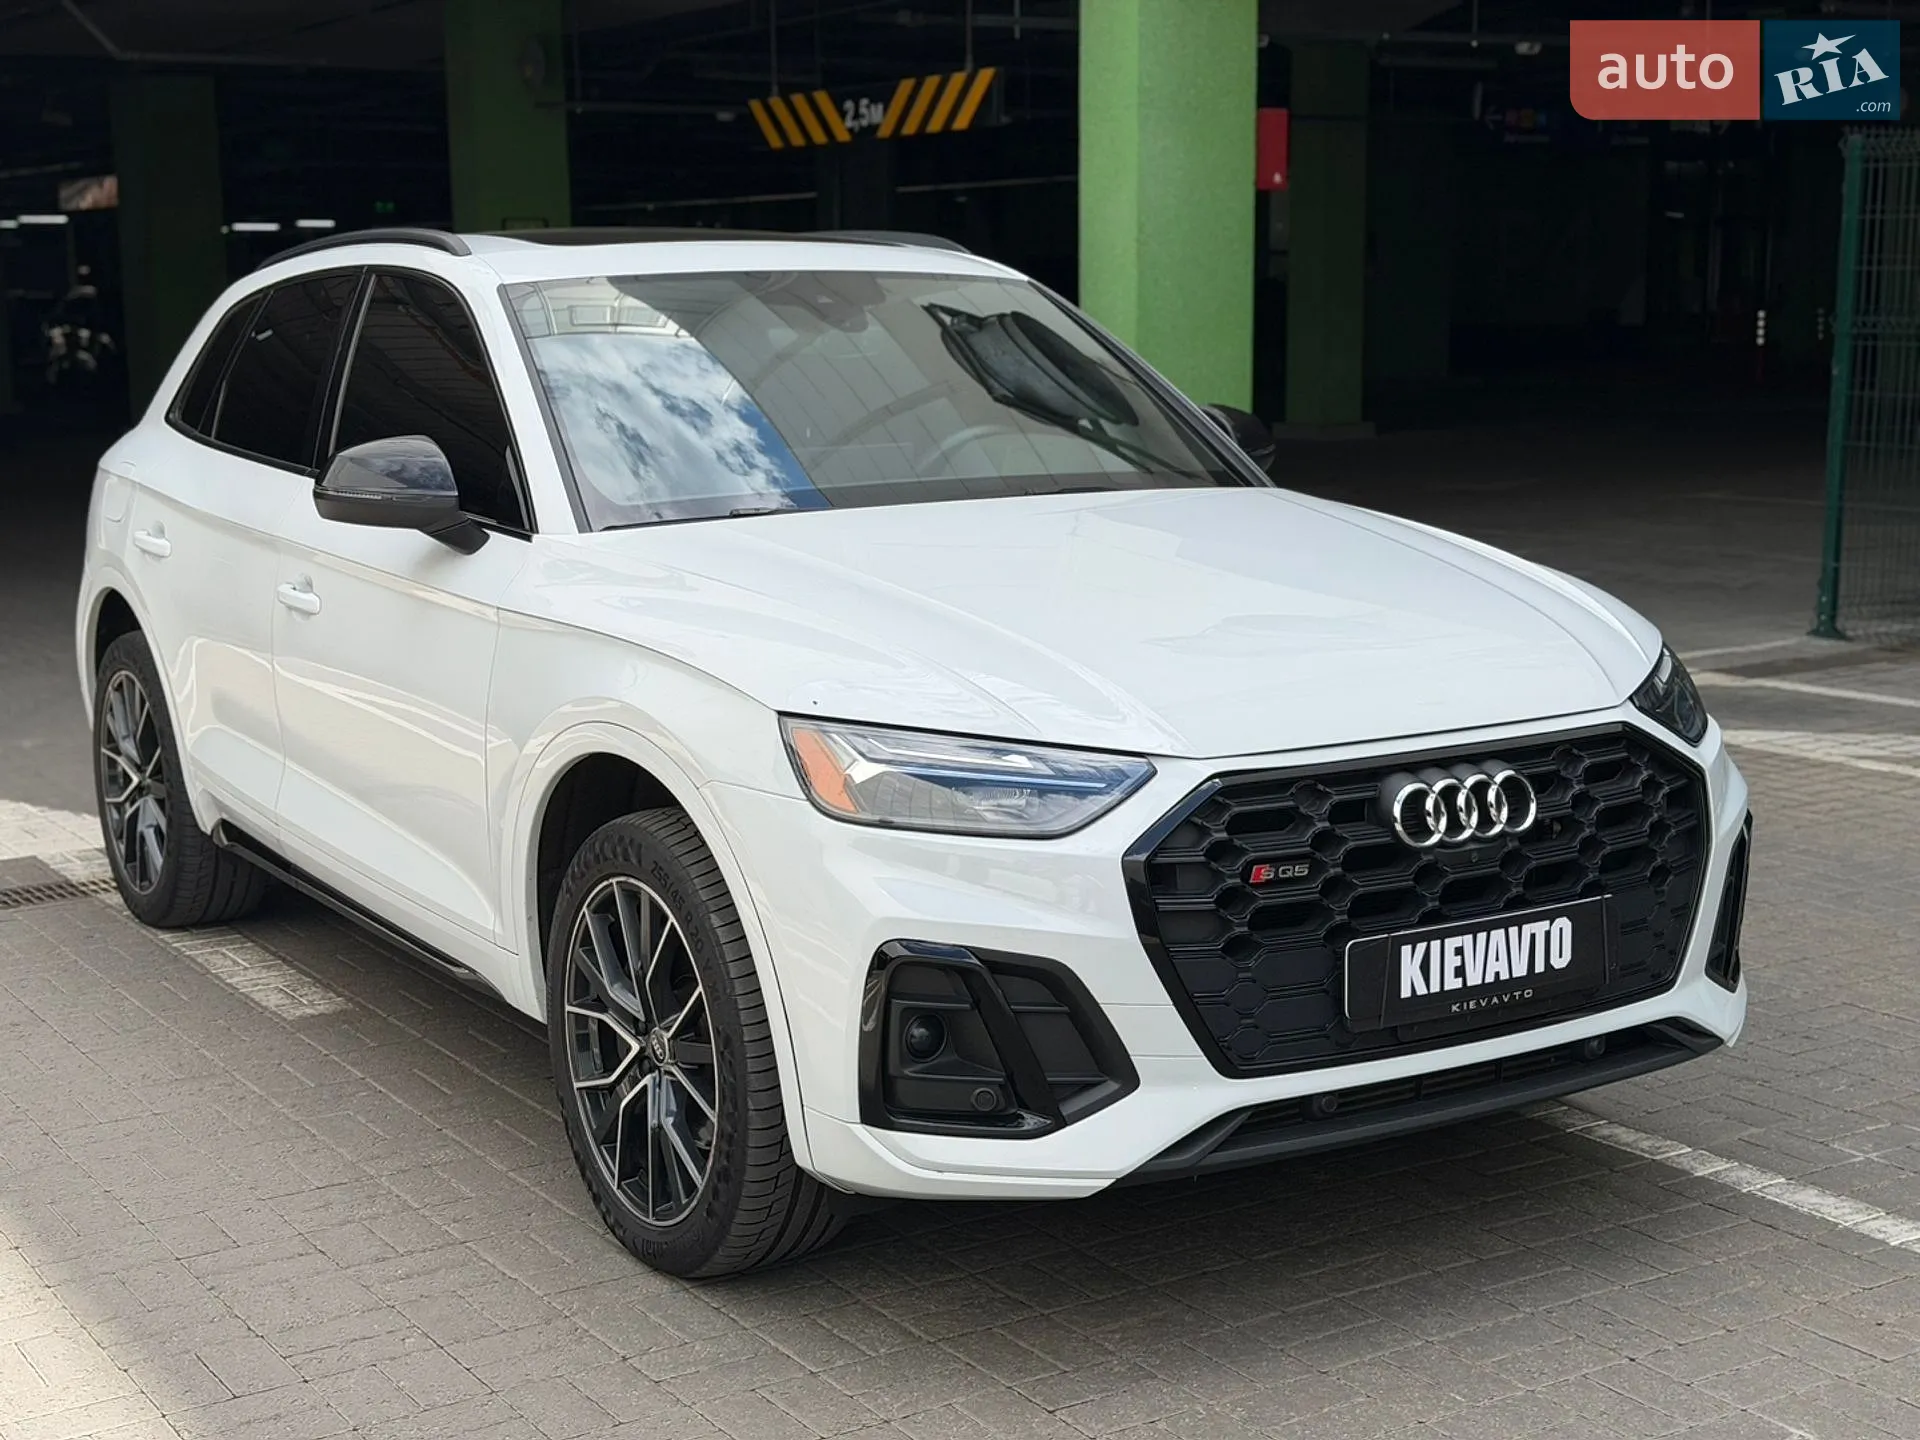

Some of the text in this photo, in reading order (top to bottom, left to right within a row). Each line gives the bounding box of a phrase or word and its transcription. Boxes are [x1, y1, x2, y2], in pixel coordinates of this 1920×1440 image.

[1256, 864, 1309, 881] SQ5
[1400, 916, 1572, 999] KIEVAVTO
[1451, 989, 1533, 1012] KIEVAVTO
